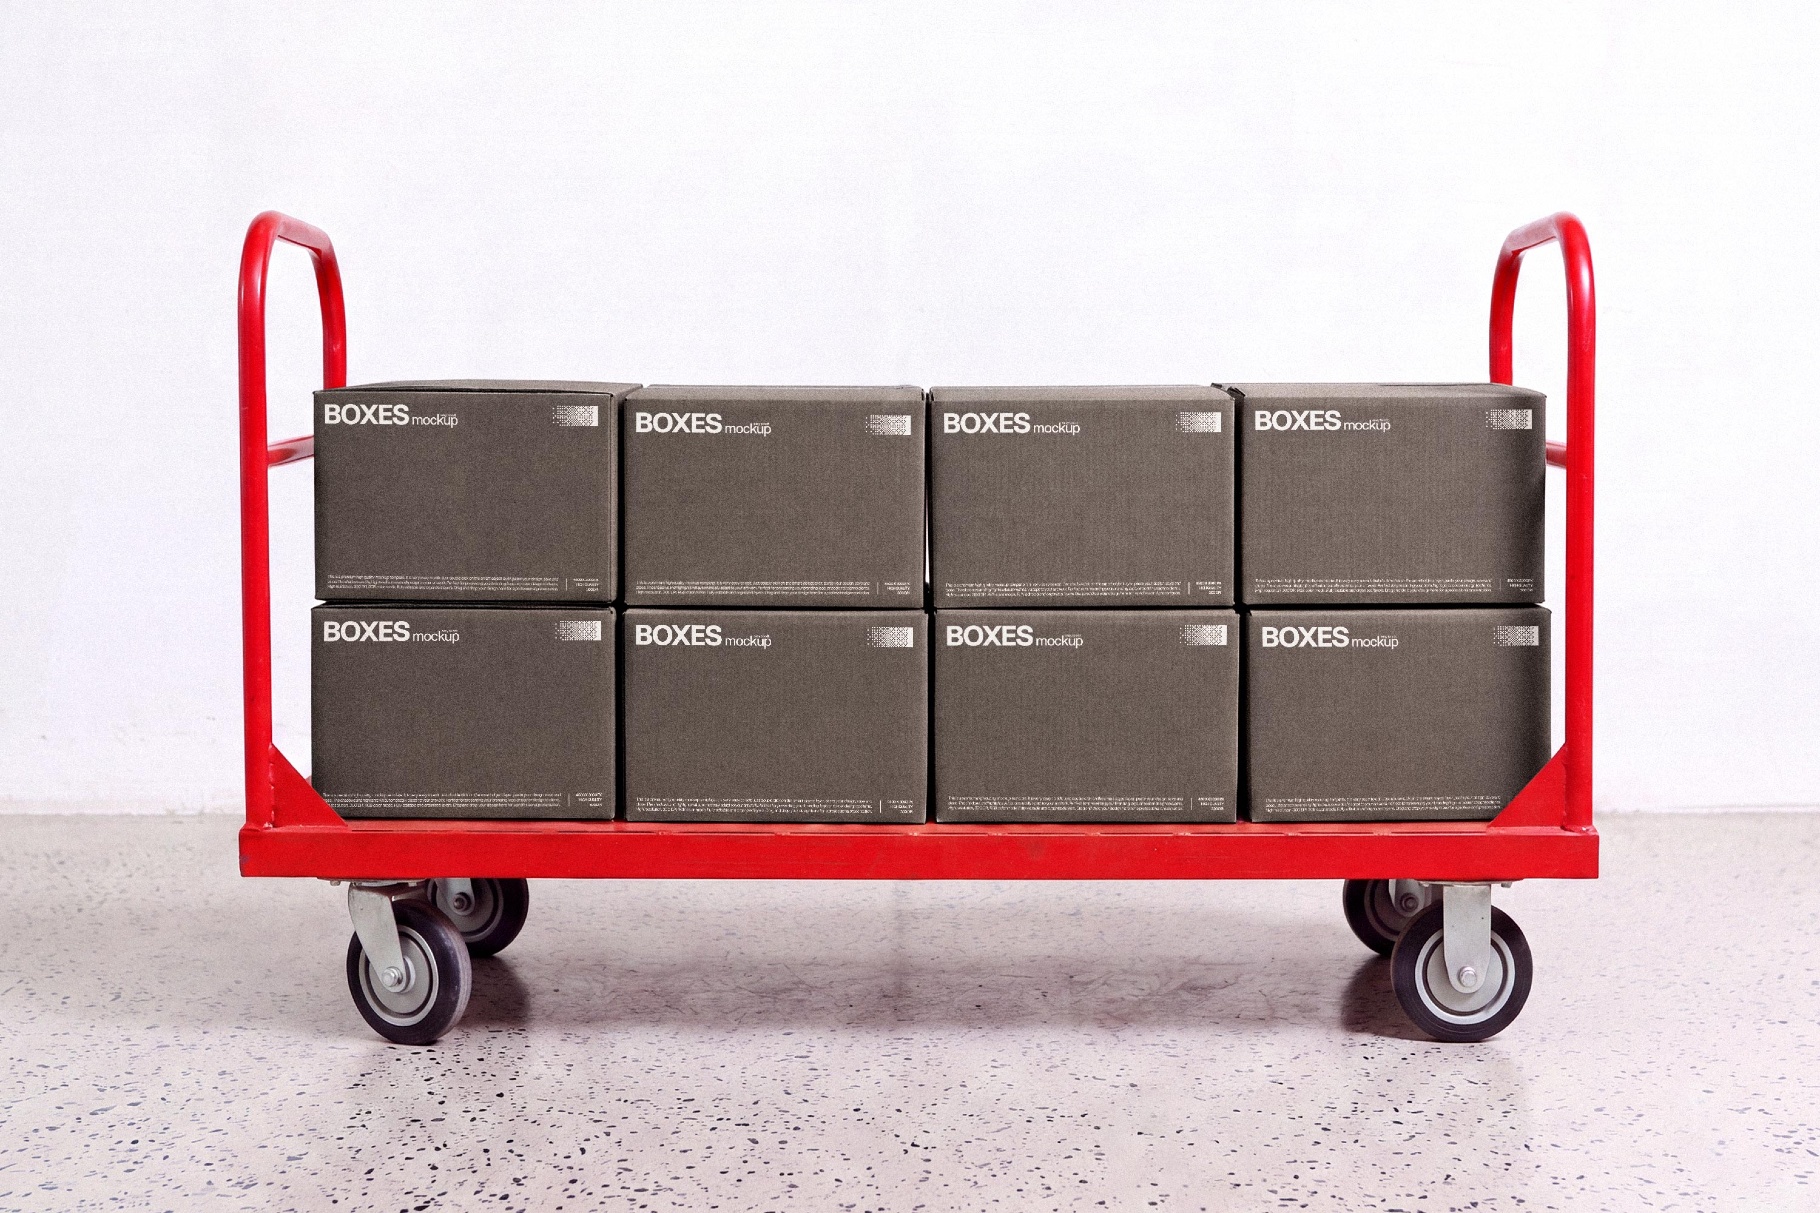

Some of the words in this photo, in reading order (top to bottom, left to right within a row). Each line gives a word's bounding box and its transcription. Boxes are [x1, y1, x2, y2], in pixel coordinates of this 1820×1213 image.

[324, 403, 410, 425] BOXES
[412, 413, 459, 428] mockup
[635, 412, 722, 434] BOXES
[725, 421, 772, 437] mockup
[944, 411, 1031, 433] BOXES
[1033, 420, 1081, 436] mockup
[1255, 410, 1342, 431] BOXES
[1344, 417, 1392, 433] mockup
[324, 620, 410, 642] BOXES
[412, 629, 460, 645] mockup
[636, 624, 723, 646] BOXES
[725, 633, 772, 649] mockup
[946, 624, 1034, 646] BOXES
[1036, 633, 1084, 649] mockup
[1262, 626, 1350, 647] BOXES
[1352, 634, 1399, 650] mockup
